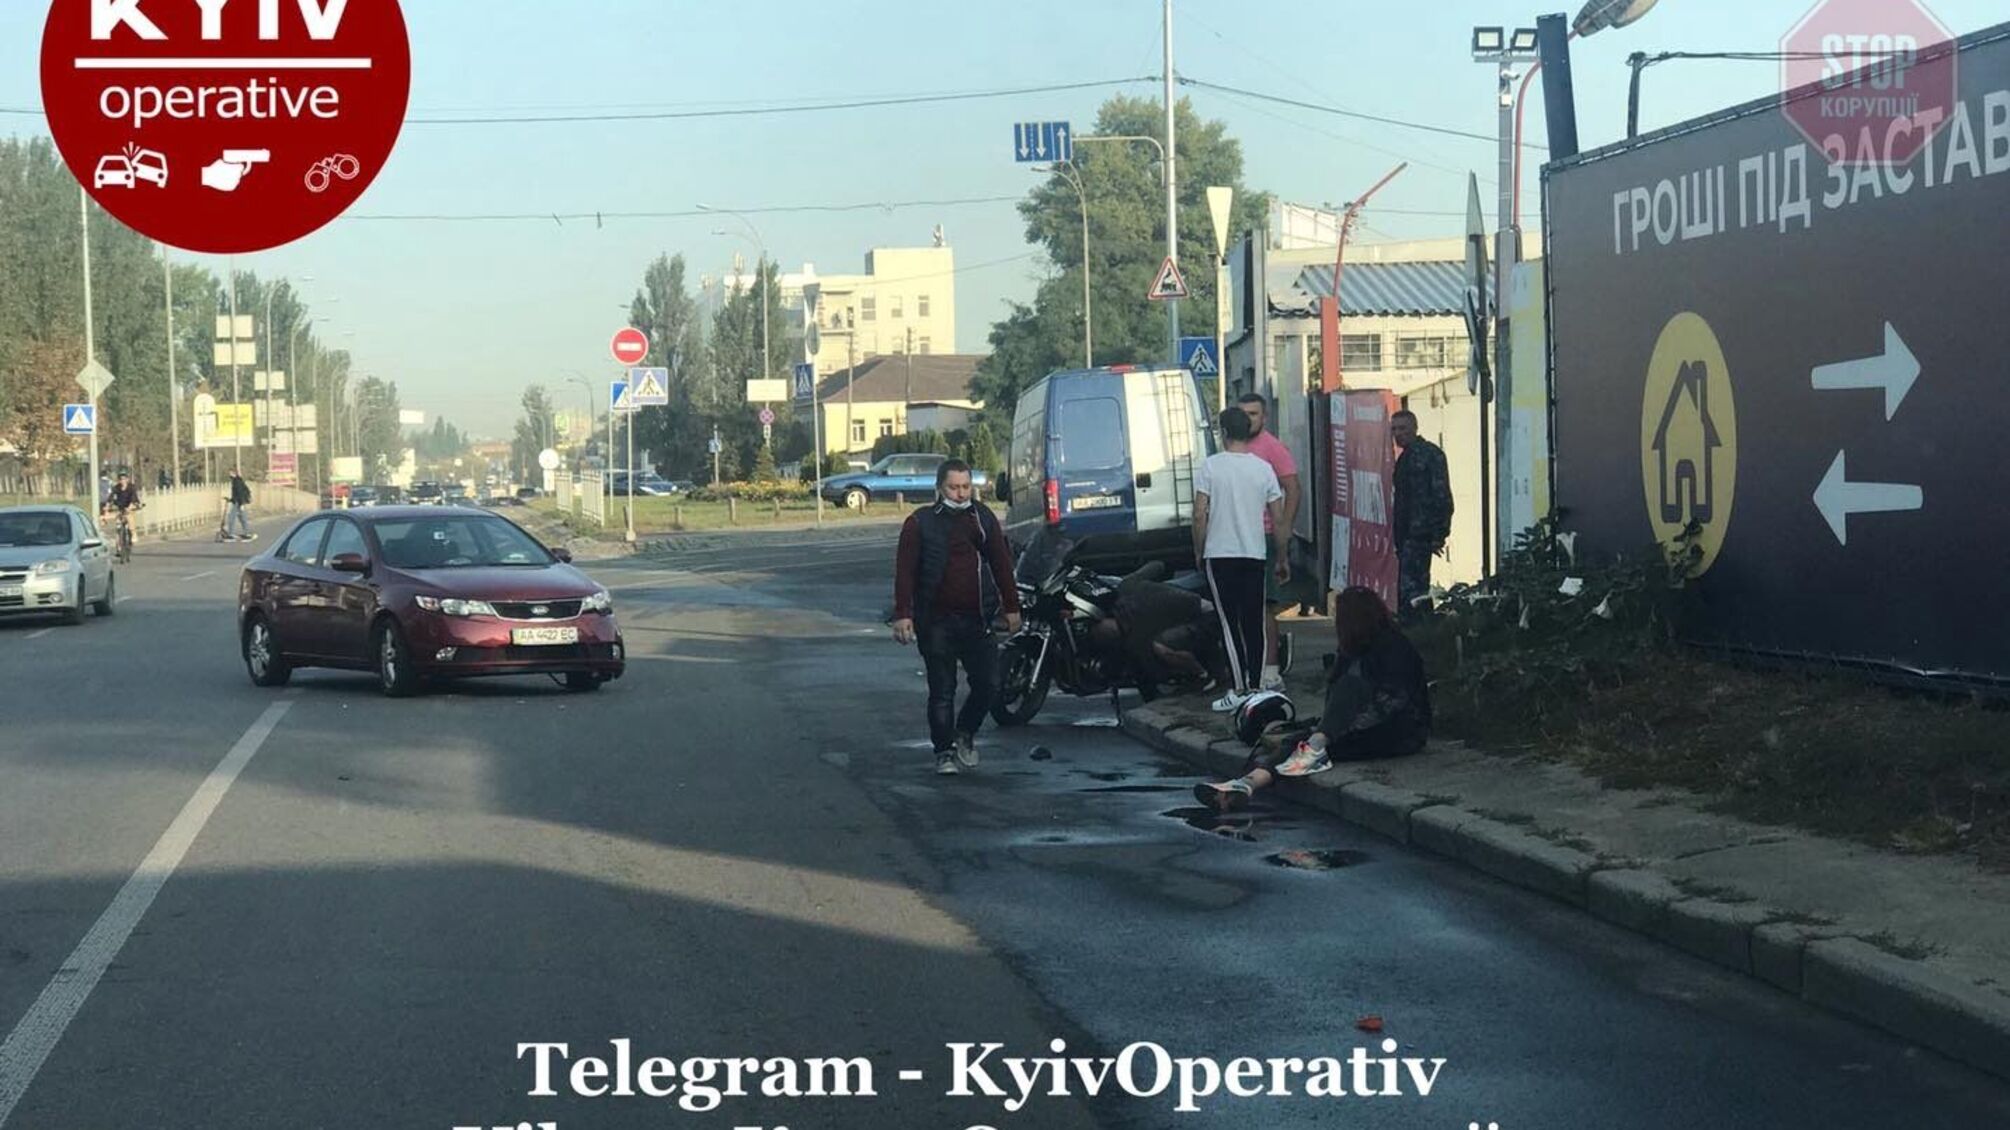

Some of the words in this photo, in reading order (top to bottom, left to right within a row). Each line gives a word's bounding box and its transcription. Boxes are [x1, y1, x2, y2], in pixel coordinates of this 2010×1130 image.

[1613, 165, 1726, 255] ГРОШІ
[1738, 143, 1812, 234] ПІД
[1822, 89, 2010, 210] ЗАСТАВ
